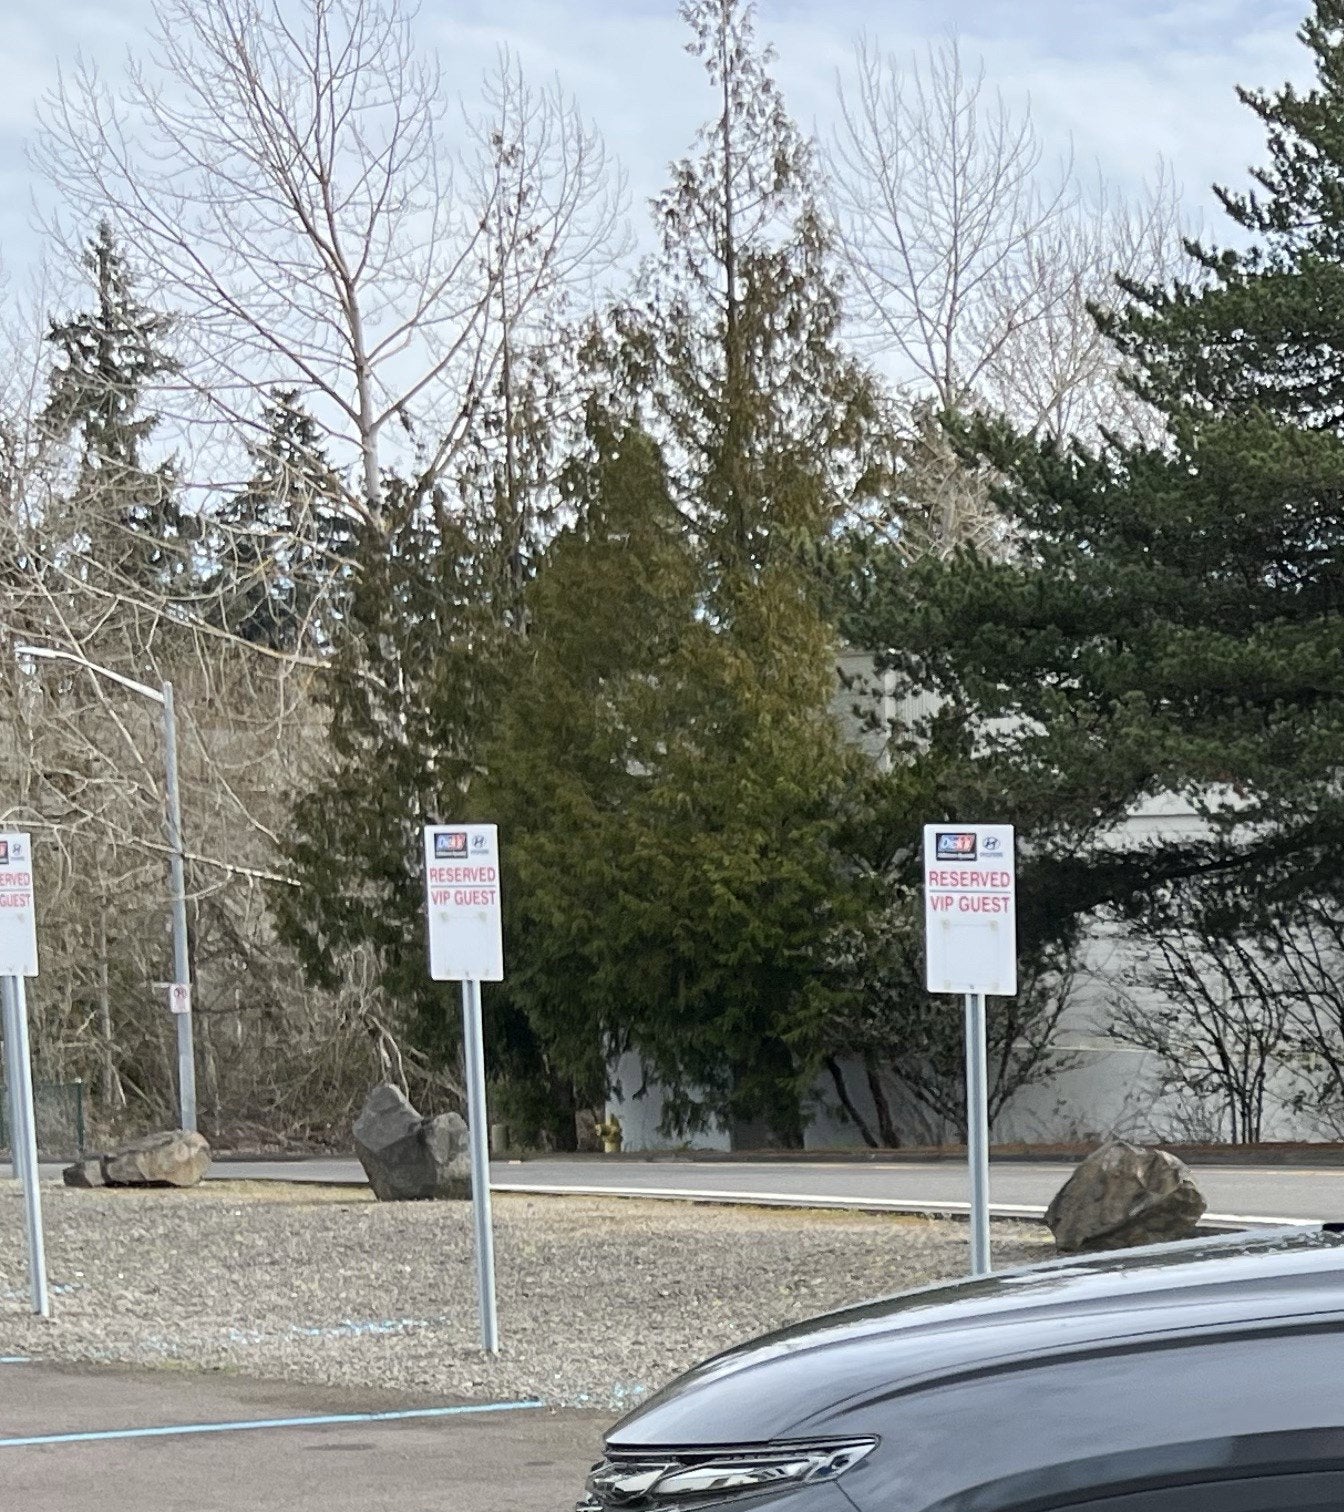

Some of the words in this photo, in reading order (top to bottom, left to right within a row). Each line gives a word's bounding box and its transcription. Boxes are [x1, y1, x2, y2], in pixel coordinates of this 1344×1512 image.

[0, 872, 31, 887] ERVED
[429, 867, 497, 883] RESERVED
[928, 870, 1011, 888] RESERVED
[430, 890, 451, 906] VIP
[454, 889, 497, 906] GUEST
[929, 896, 954, 912] VIP
[958, 896, 1011, 914] GUEST
